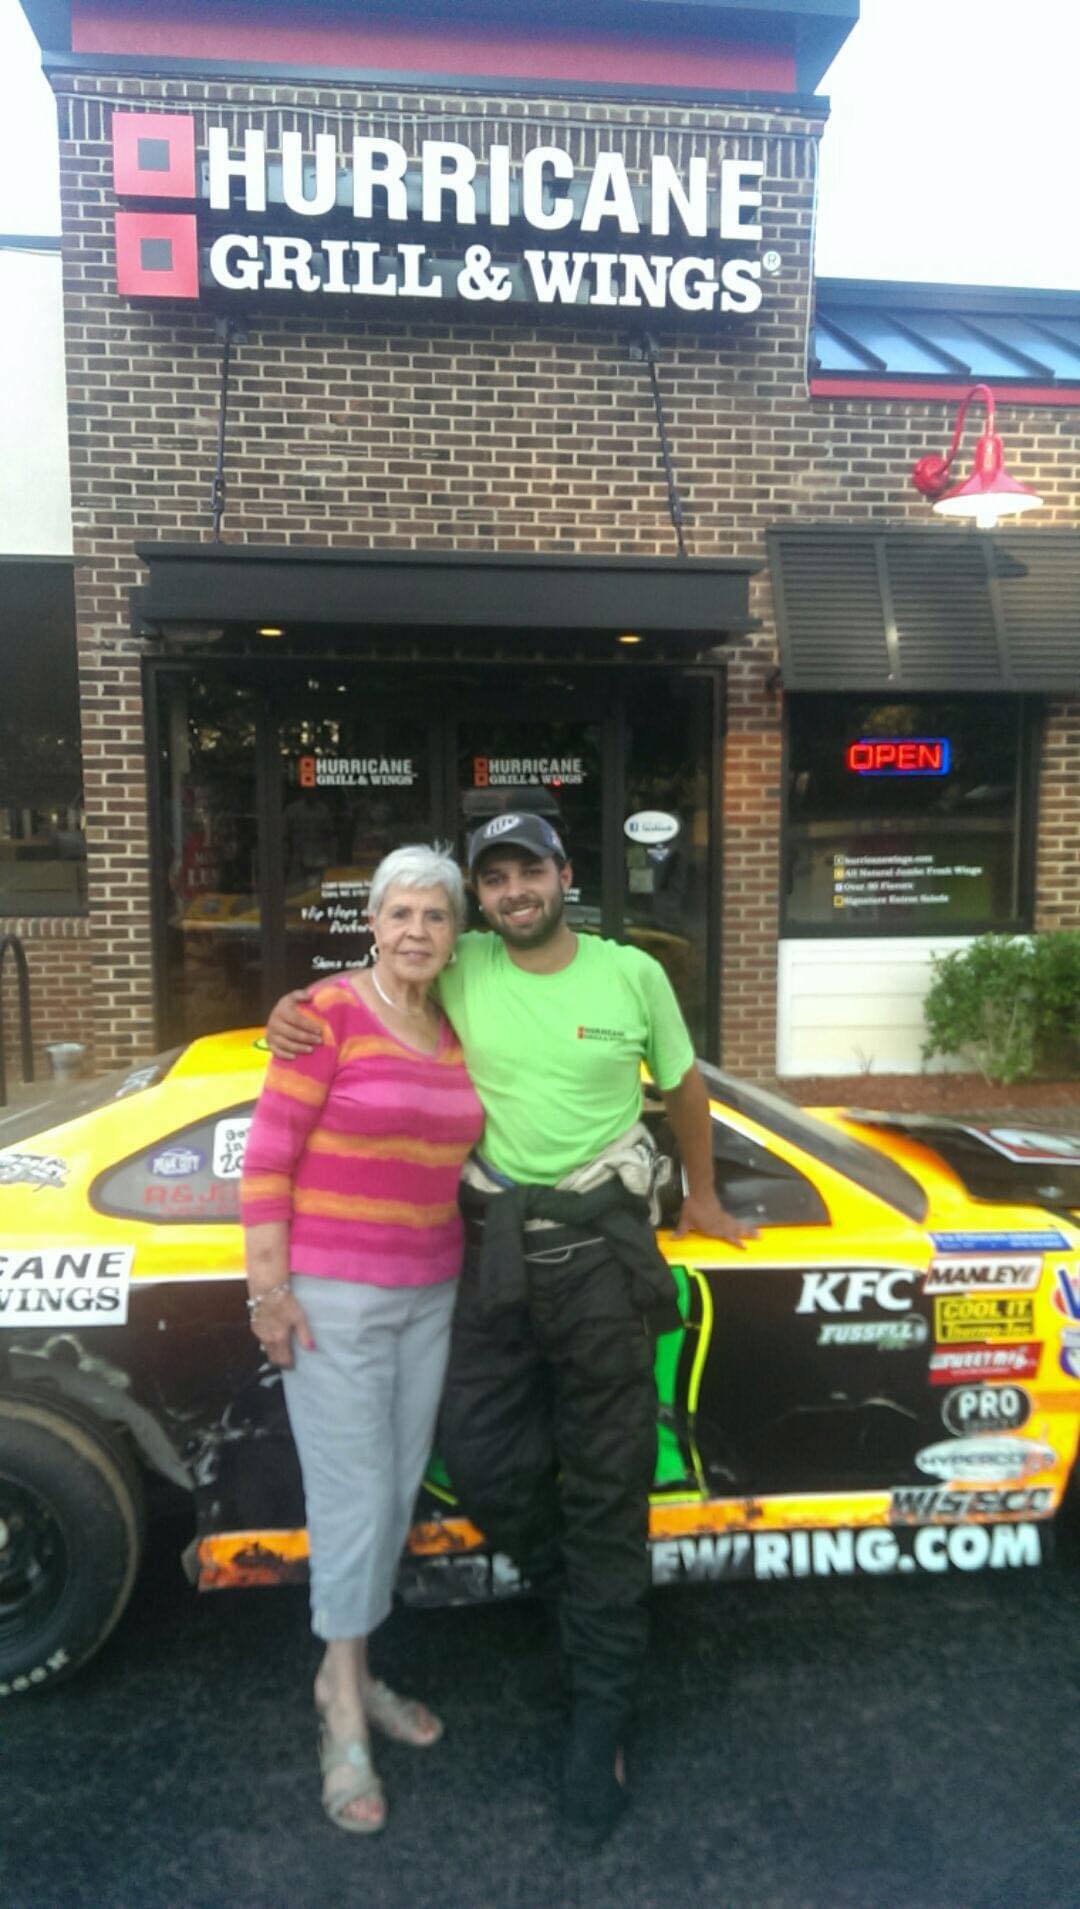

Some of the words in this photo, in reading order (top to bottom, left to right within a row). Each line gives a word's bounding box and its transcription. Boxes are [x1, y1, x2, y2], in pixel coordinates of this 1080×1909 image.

[209, 127, 764, 240] HURRICANE
[210, 234, 442, 298] GRILL
[457, 244, 512, 300] &
[524, 250, 763, 314] WINGS
[316, 758, 412, 774] HURRICANE
[489, 758, 582, 773] HURRICANE
[849, 744, 941, 770] OPEN
[316, 775, 357, 786] GRILL
[358, 775, 369, 786] &
[370, 775, 414, 786] WINGS
[489, 774, 527, 785] GRILL
[541, 774, 584, 785] WINGS
[928, 1265, 1024, 1284] MANLEY
[795, 1271, 914, 1314] KFC
[958, 1389, 1019, 1420] PRO
